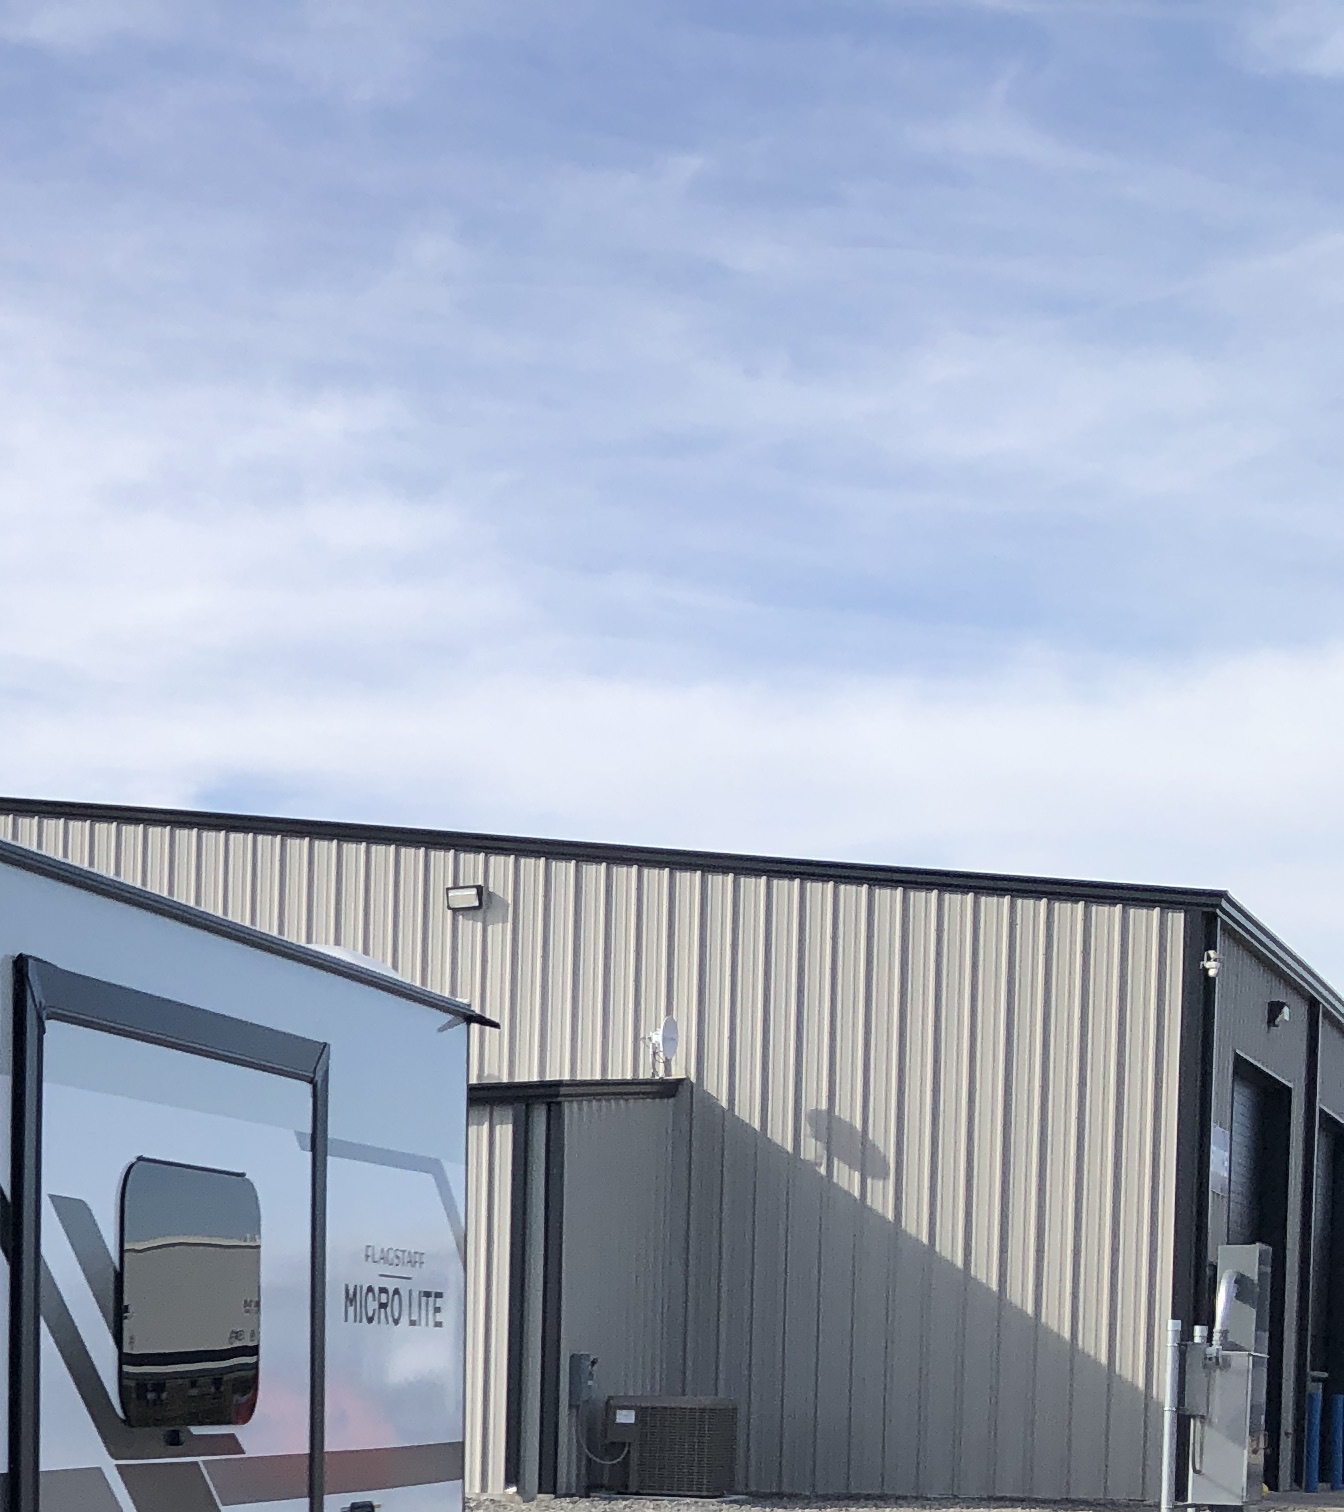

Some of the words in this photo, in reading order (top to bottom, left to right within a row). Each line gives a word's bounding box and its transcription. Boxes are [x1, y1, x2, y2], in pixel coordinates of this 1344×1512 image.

[364, 1244, 426, 1269] FLAGSTAFF
[343, 1283, 403, 1327] MICRO
[408, 1288, 444, 1329] LITE
